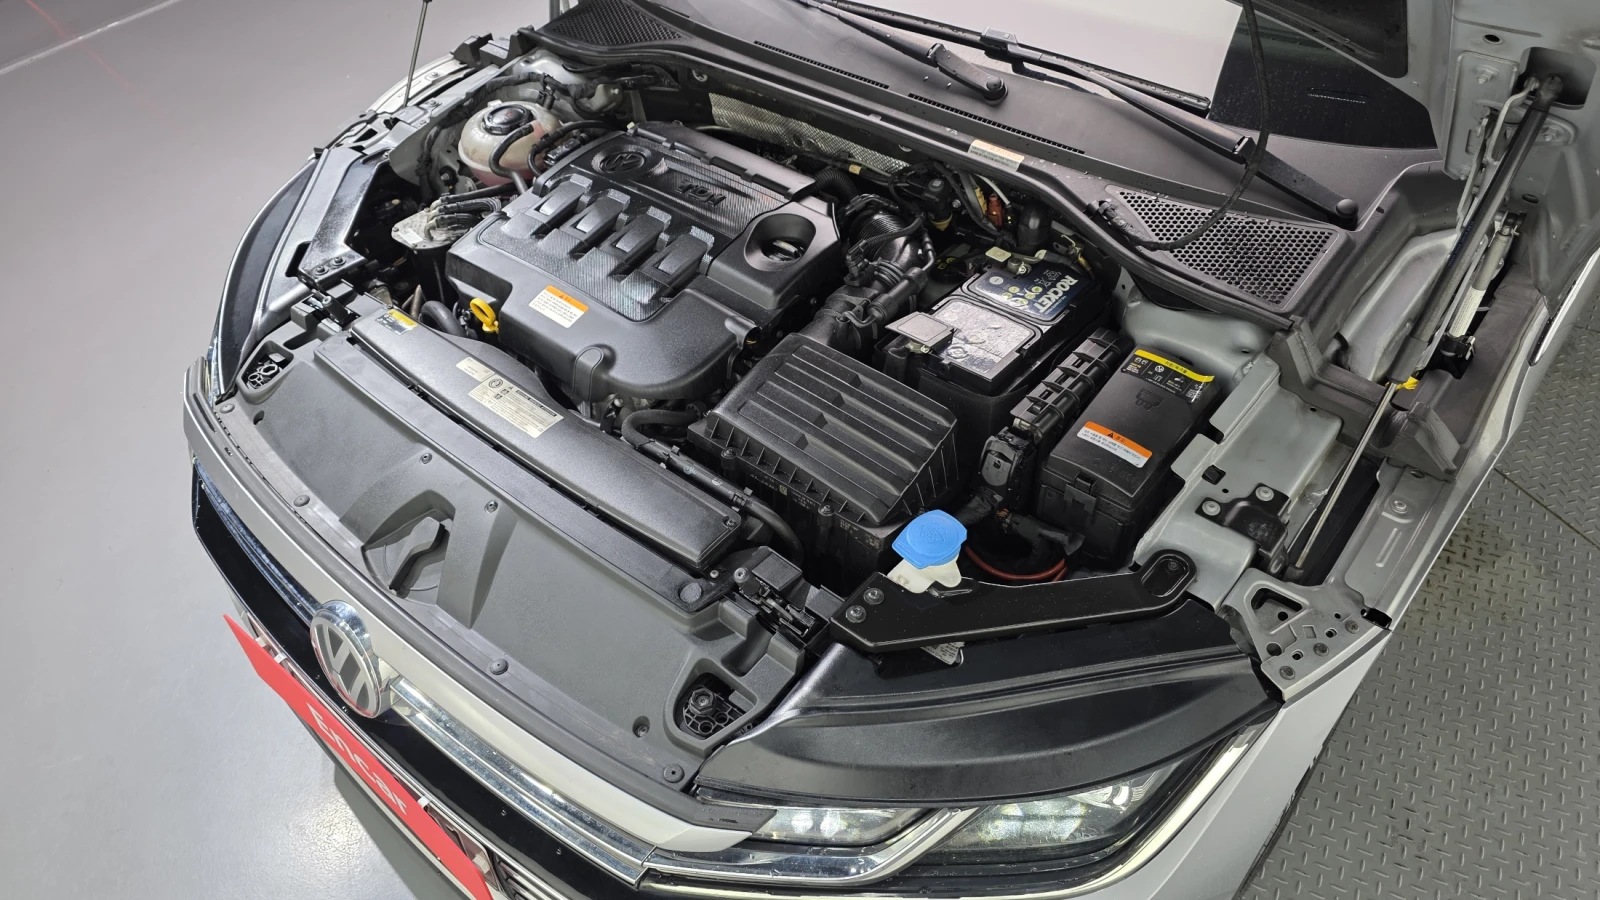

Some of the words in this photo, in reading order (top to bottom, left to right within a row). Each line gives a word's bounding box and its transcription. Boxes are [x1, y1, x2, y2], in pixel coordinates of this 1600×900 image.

[676, 180, 727, 206] TDI
[1033, 275, 1078, 313] ROCKET
[306, 702, 407, 815] Encar
